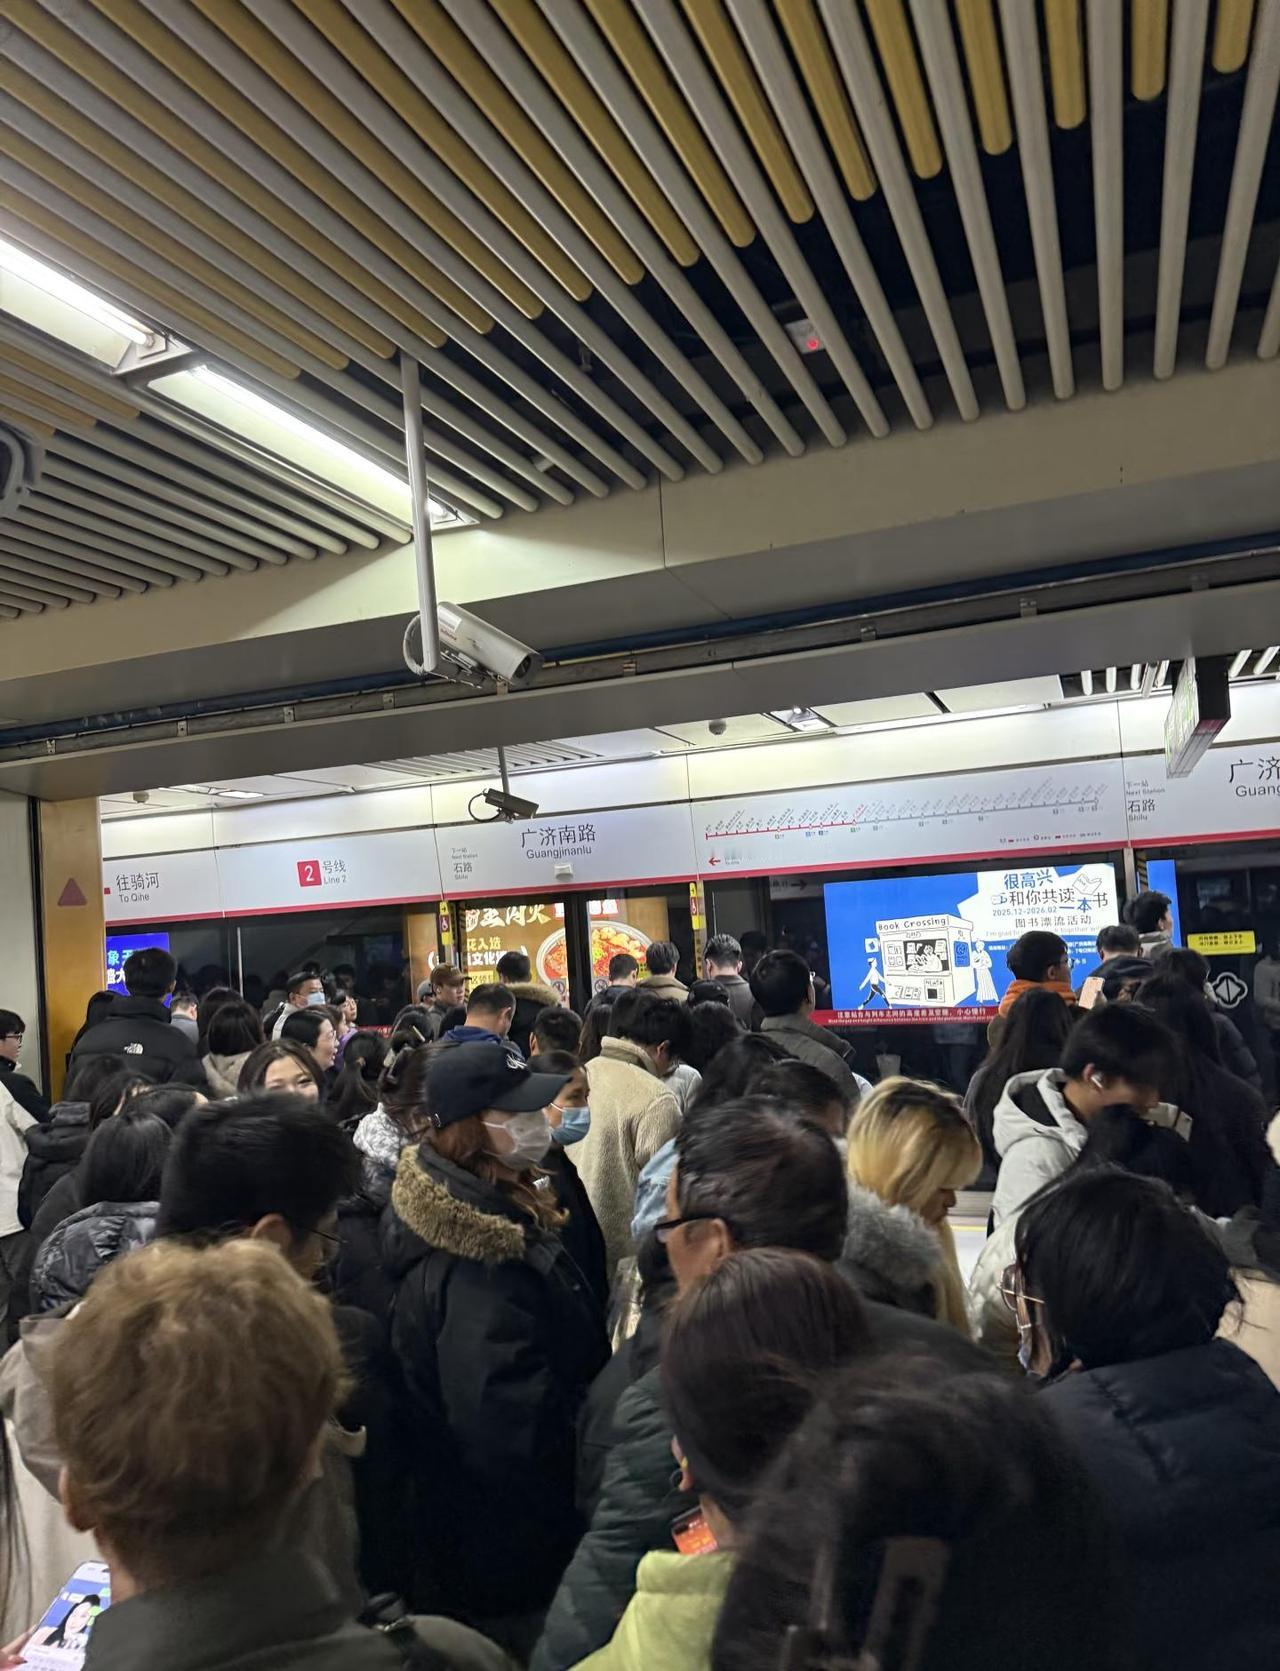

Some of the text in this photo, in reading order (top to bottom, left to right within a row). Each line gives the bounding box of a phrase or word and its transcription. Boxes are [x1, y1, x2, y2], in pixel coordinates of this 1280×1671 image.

[1229, 756, 1280, 783] 广济
[1127, 798, 1155, 812] 石路
[521, 823, 596, 848] 广济南路
[526, 845, 592, 859] Guangjinanlu
[304, 865, 315, 882] 2
[322, 859, 346, 874] 号线
[453, 862, 473, 873] 石路
[116, 872, 160, 892] 往骑河
[323, 877, 340, 885] Line
[1004, 869, 1053, 889] 很高兴
[119, 892, 150, 903] To Qihe
[992, 906, 1057, 917] 2025.12-2026.02
[878, 917, 947, 931] Book Crossing
[1015, 915, 1093, 928] 图书漂流活动
